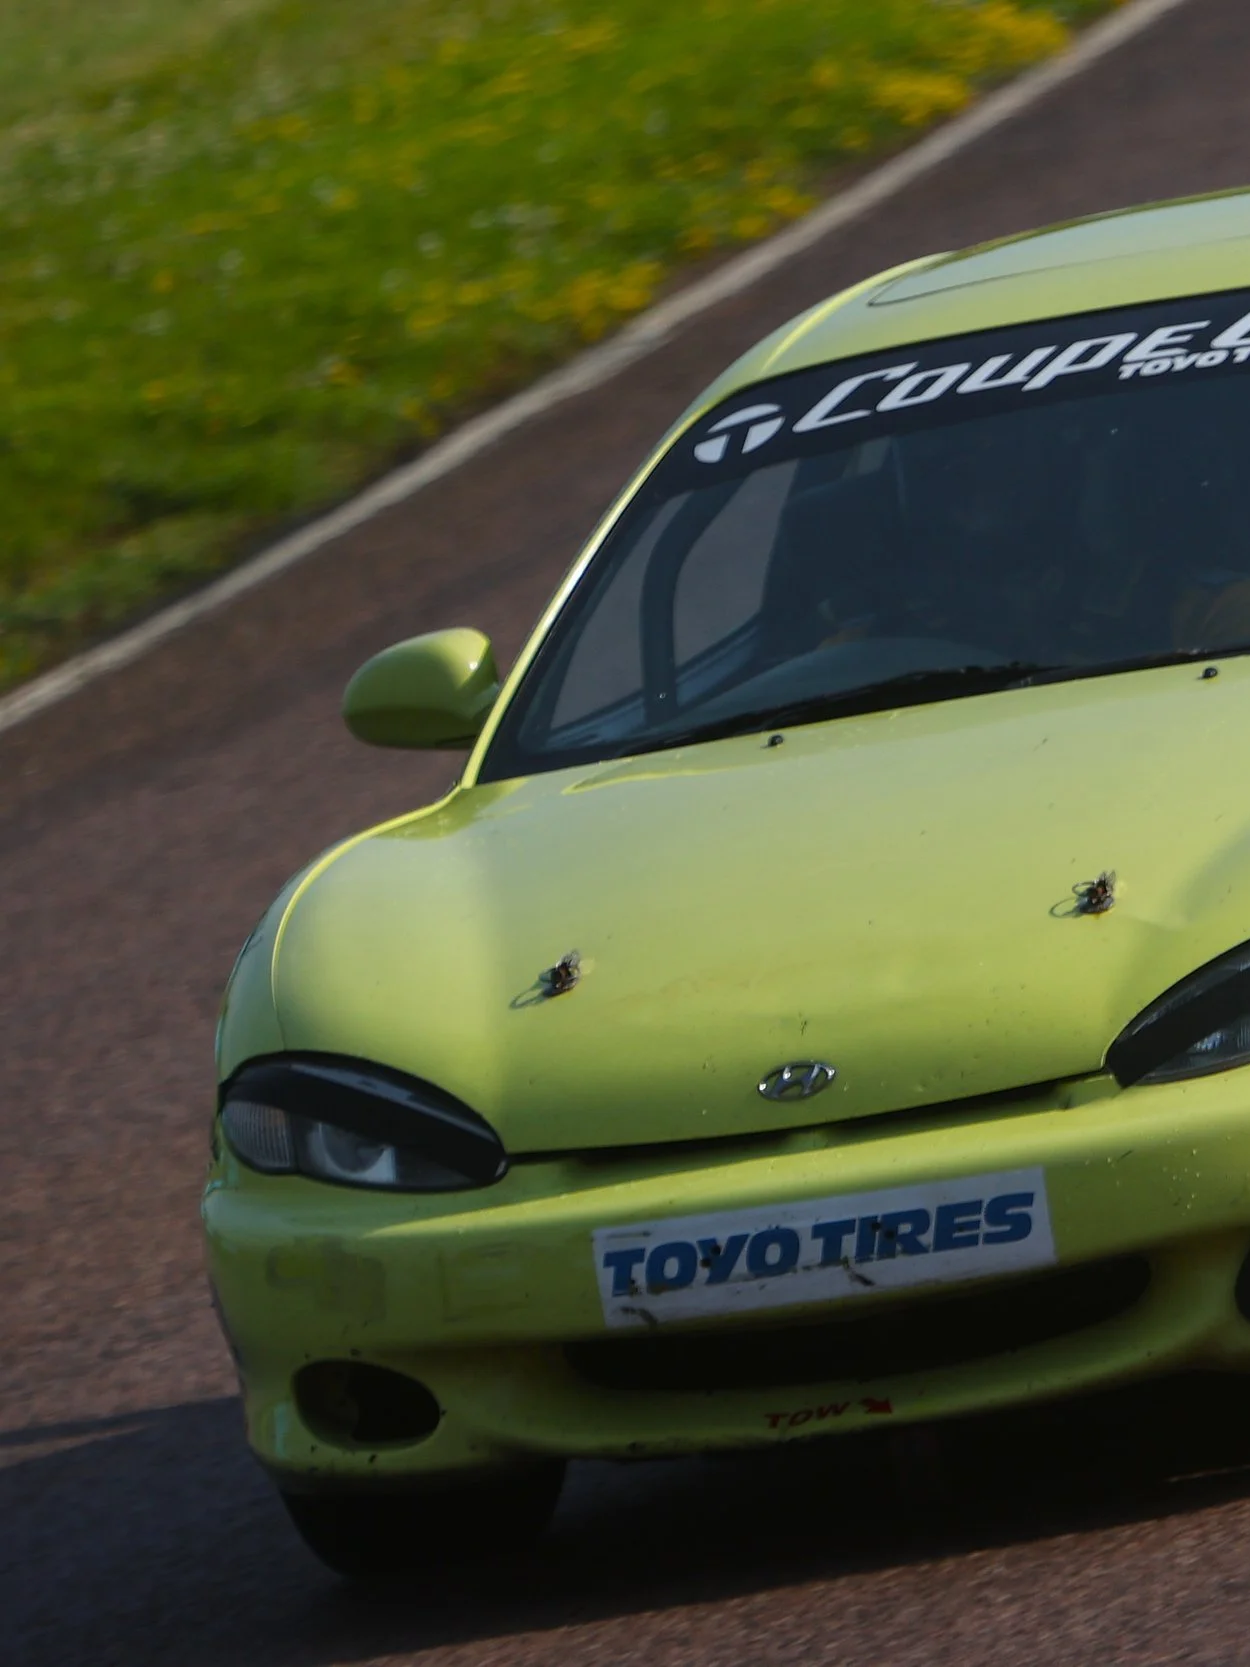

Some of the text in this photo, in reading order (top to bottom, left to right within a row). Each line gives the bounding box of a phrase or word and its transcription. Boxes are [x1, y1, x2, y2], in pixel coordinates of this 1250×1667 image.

[1118, 351, 1228, 380] TOYO
[603, 1192, 1035, 1297] TOYO TIRES
[764, 1402, 852, 1429] TOW
